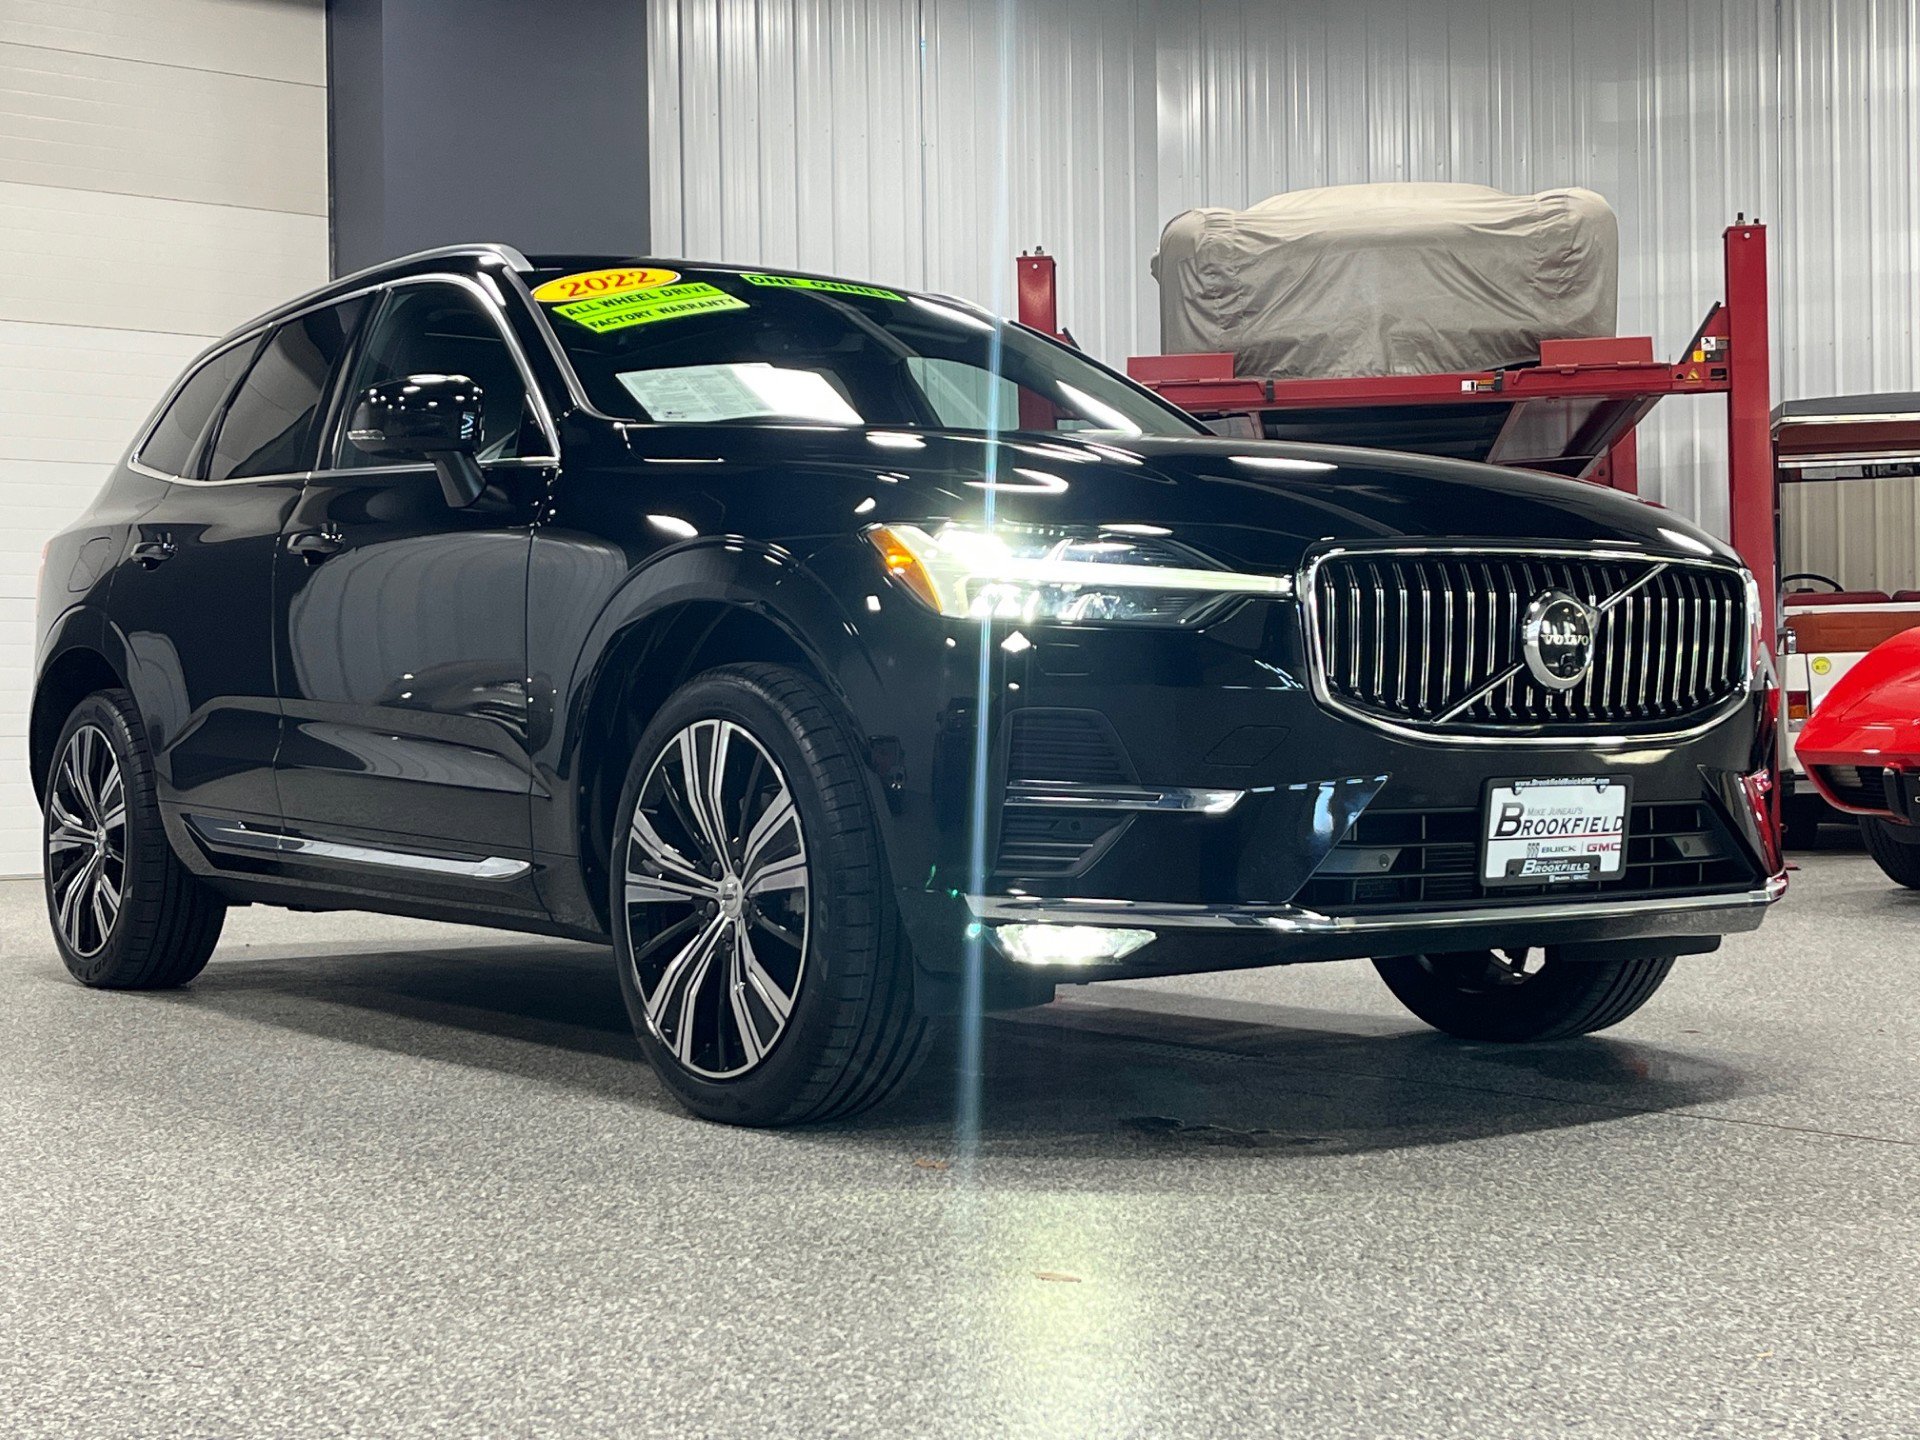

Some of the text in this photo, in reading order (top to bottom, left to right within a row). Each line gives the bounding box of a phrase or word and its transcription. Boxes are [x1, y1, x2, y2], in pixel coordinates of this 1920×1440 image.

[560, 271, 656, 297] 2022
[749, 276, 895, 298] ONE OWNER
[565, 284, 713, 316] ALL WHEEL DRIVE
[588, 298, 736, 328] FACTORY WARRANTY
[1540, 634, 1589, 646] VOLVO
[1494, 802, 1624, 837] BROOKFIELD
[1541, 842, 1622, 854] BUICK GMC
[1521, 859, 1591, 874] BROOKFIELD
